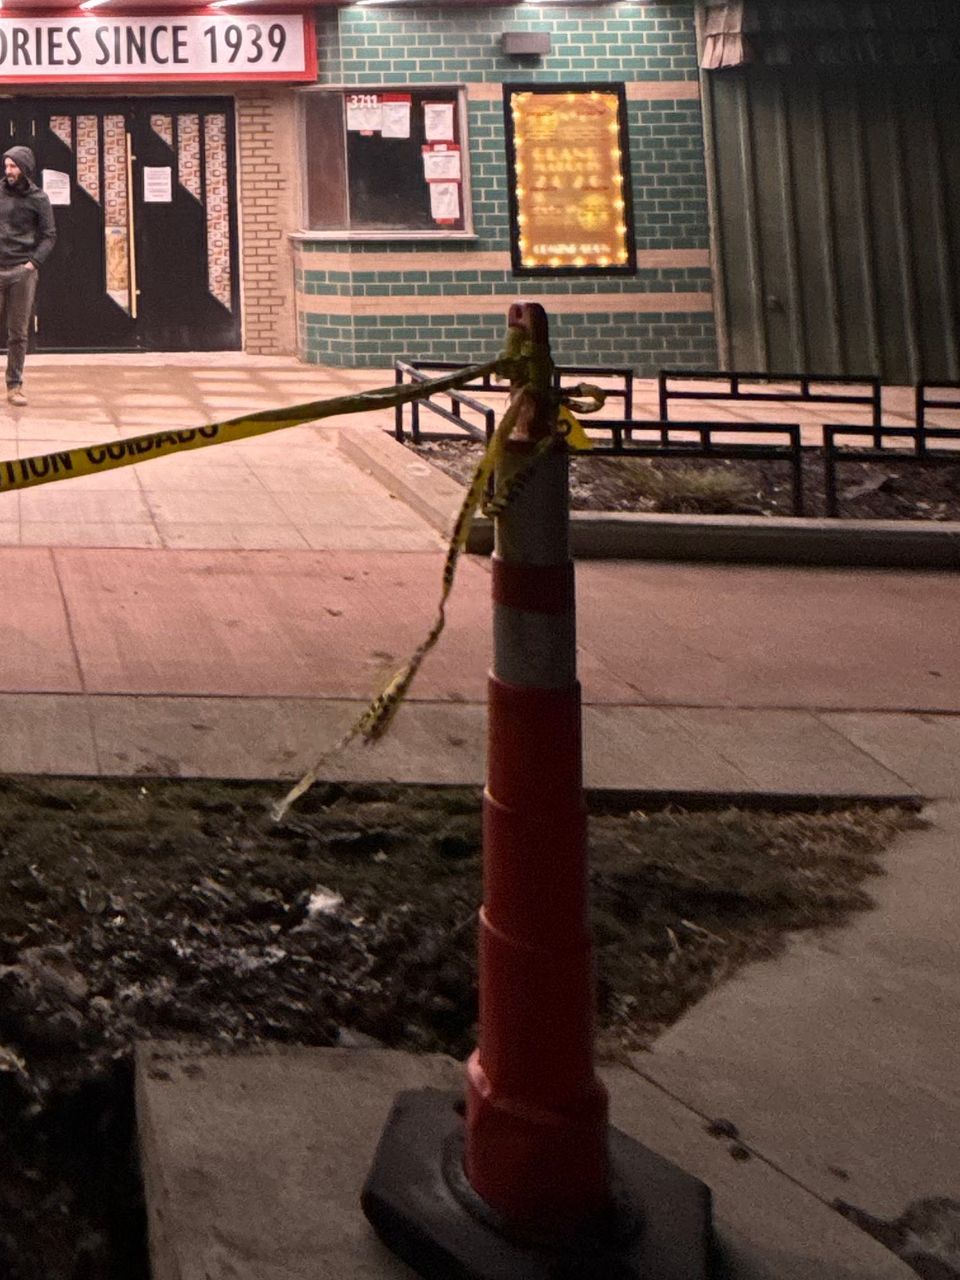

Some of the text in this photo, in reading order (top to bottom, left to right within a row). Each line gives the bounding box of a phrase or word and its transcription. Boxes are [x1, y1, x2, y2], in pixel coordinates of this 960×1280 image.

[95, 24, 189, 65] SINCE
[203, 23, 287, 63] 1939
[349, 94, 379, 109] 3711
